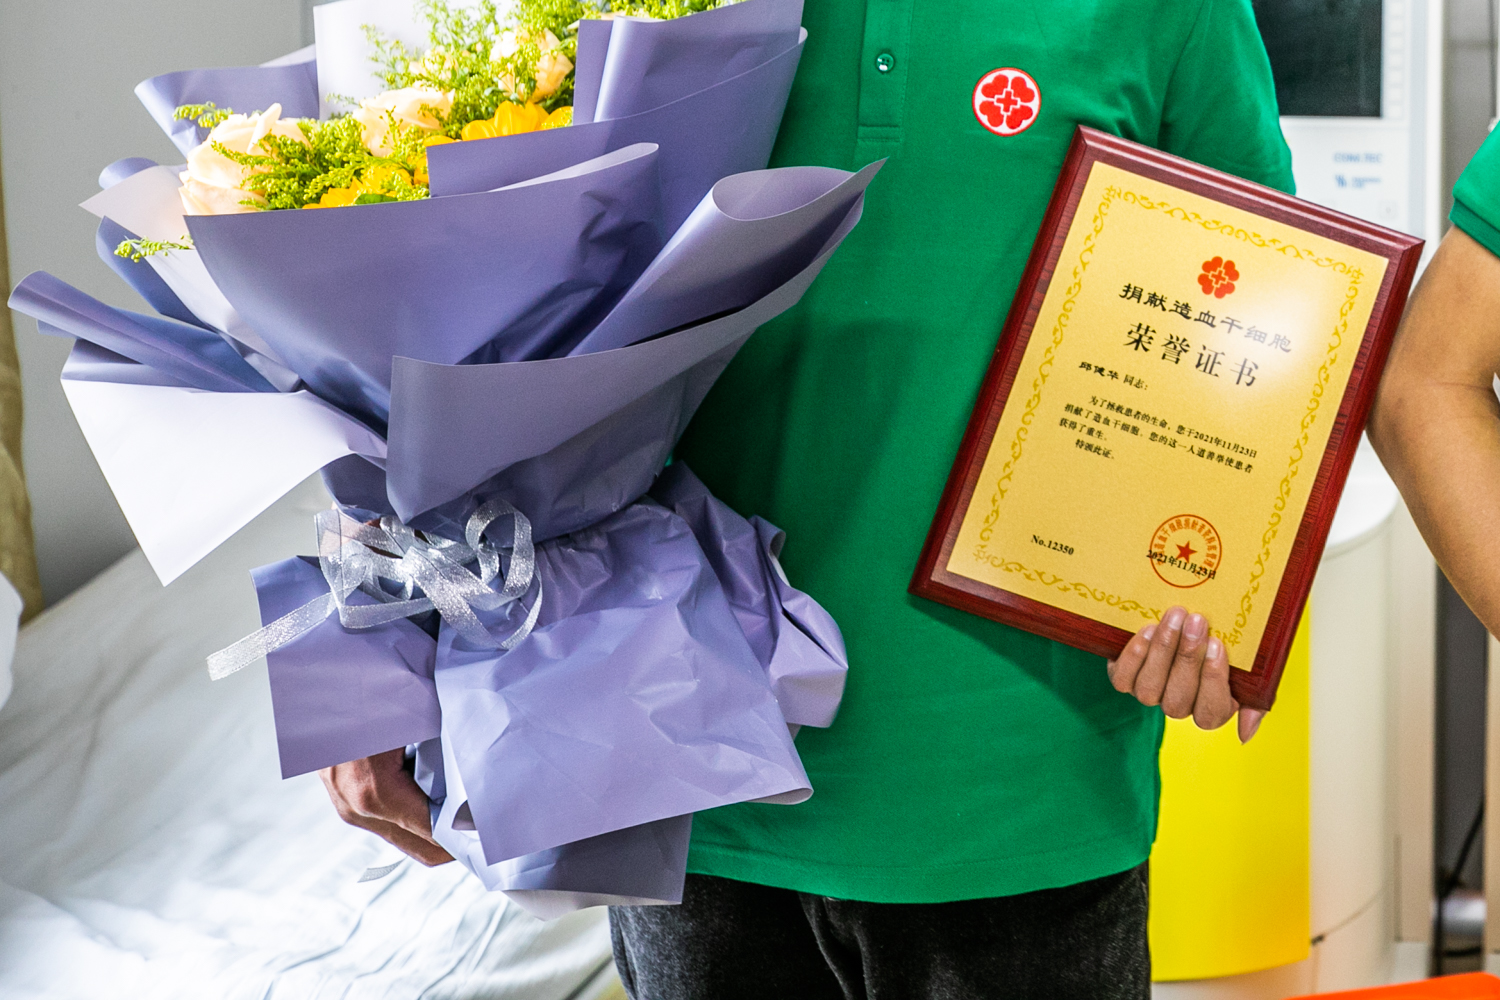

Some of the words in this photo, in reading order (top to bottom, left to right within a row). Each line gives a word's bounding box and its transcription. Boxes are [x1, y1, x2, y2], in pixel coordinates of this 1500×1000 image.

[1117, 283, 1293, 353] 捐献造血干细胞
[1123, 322, 1260, 386] 荣誉证书
[1031, 534, 1074, 555] No.12350
[1146, 550, 1217, 580] 2021年11月23日
